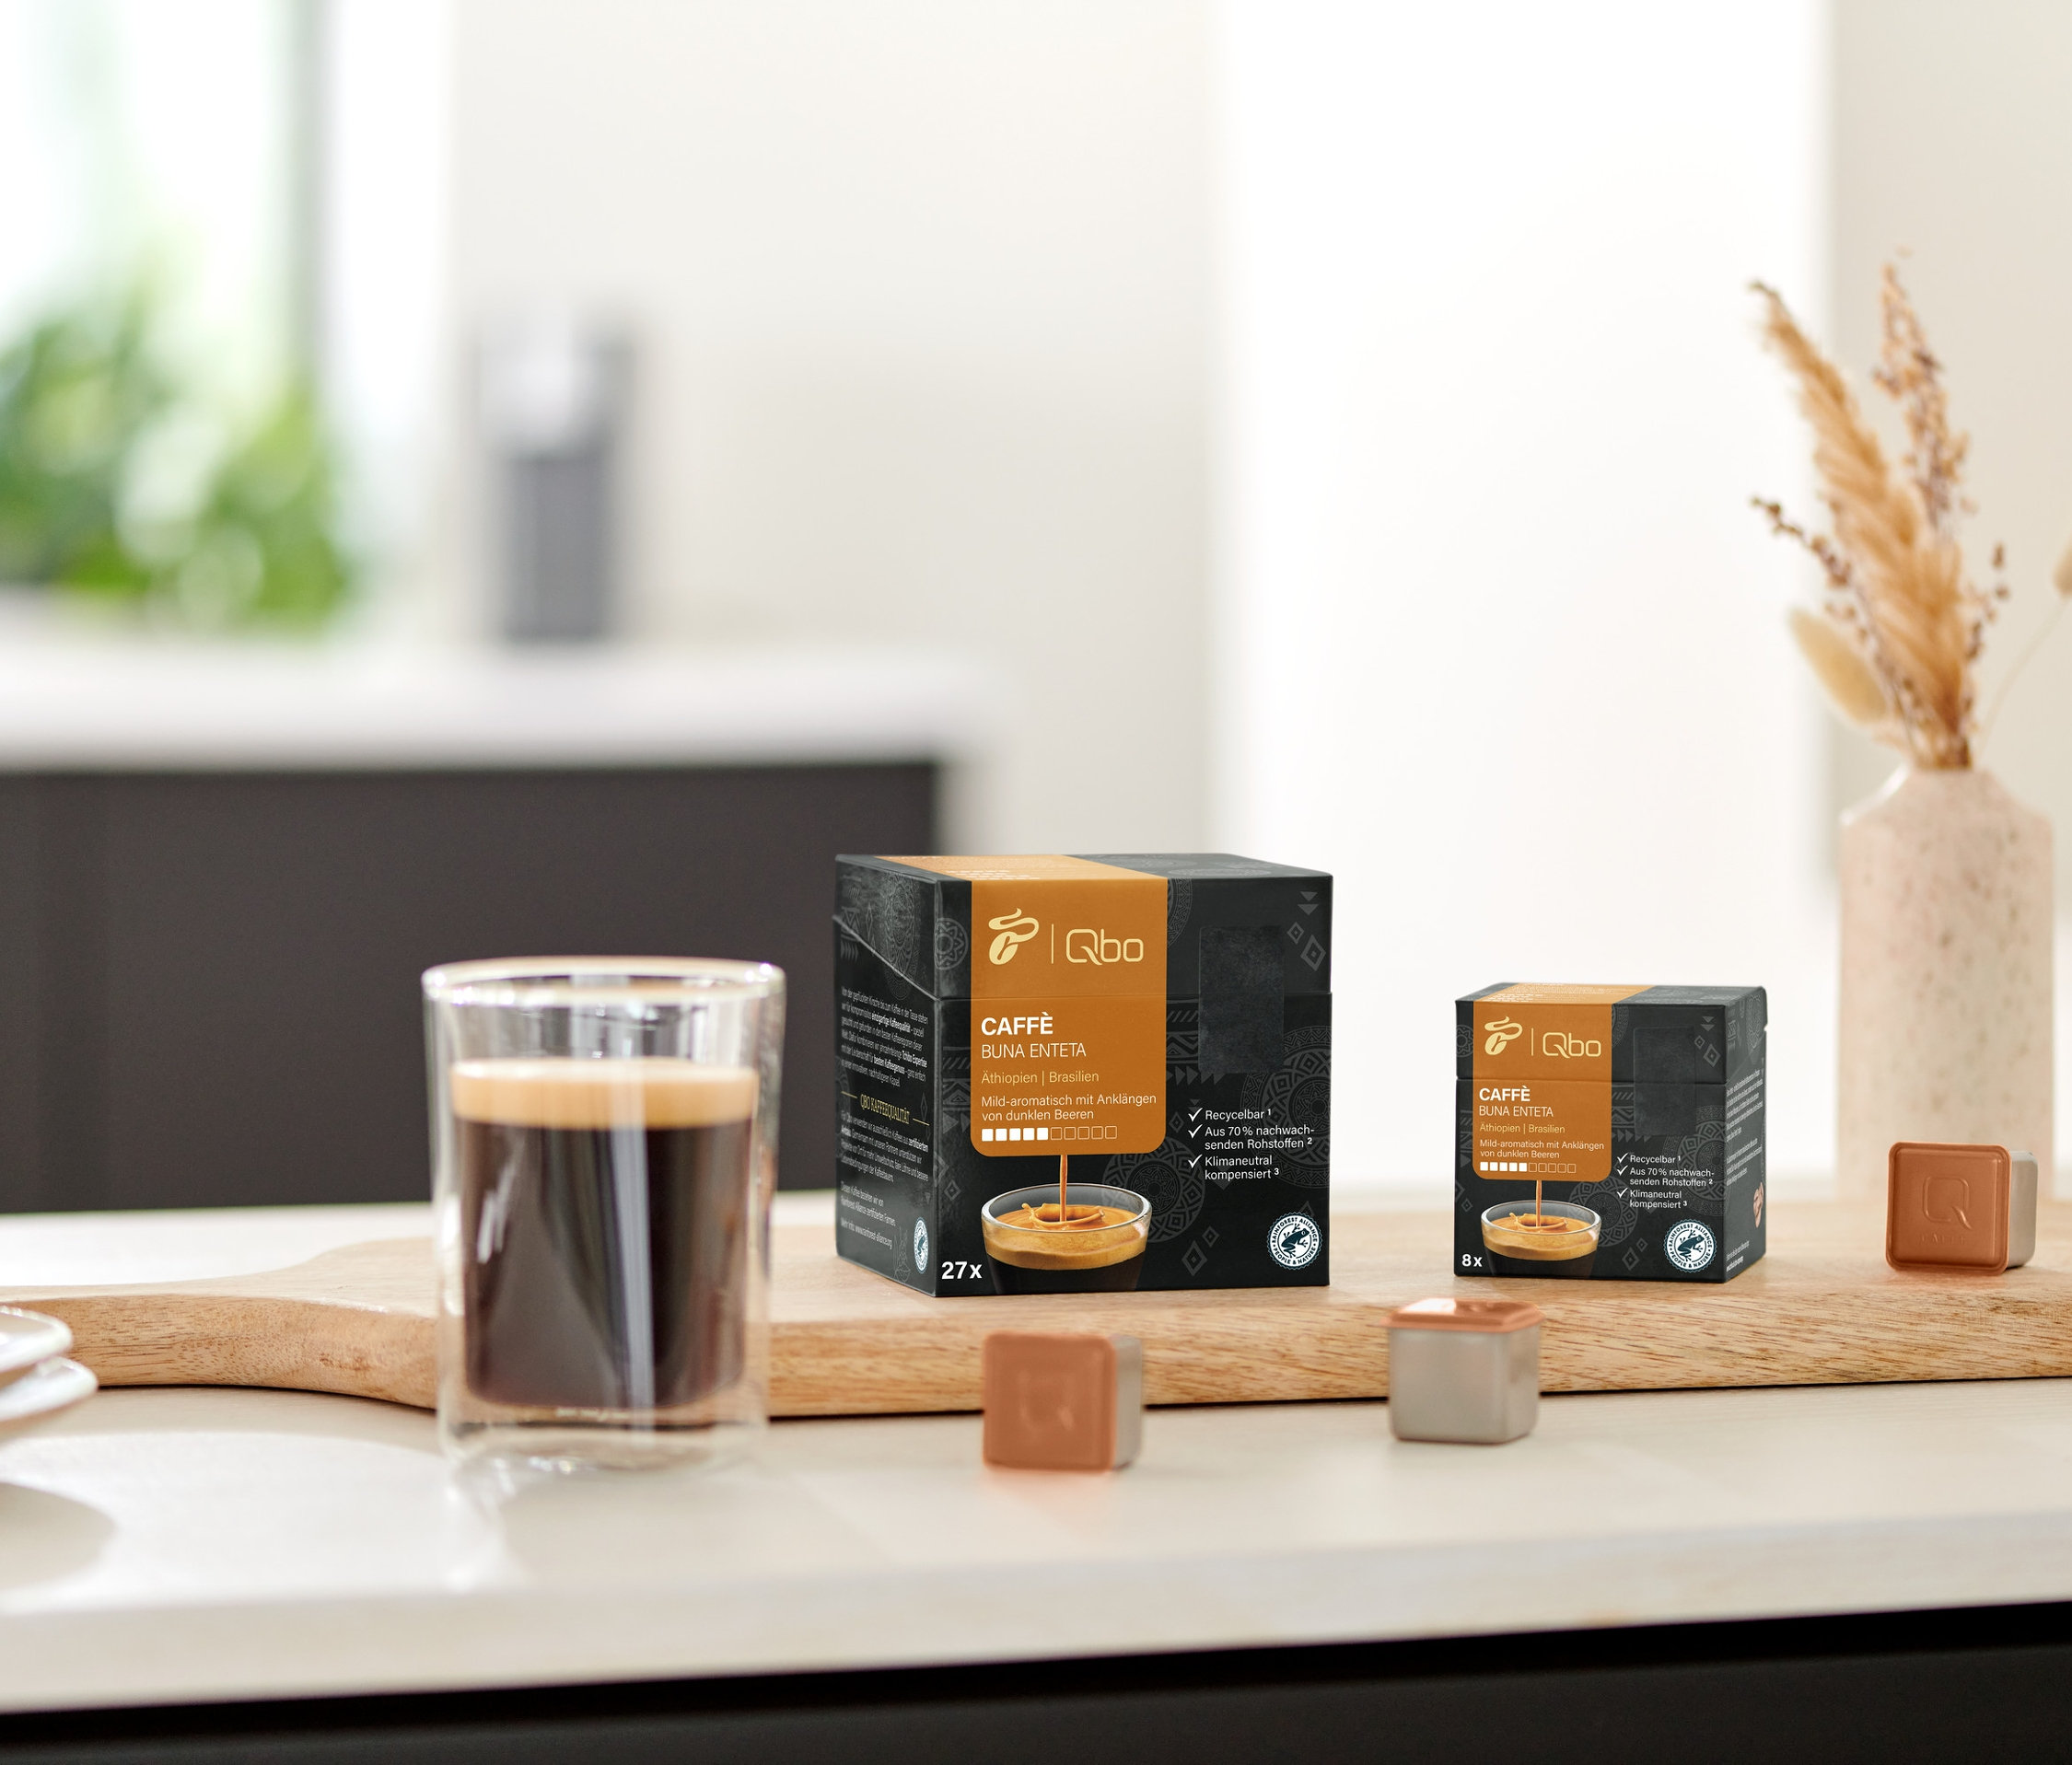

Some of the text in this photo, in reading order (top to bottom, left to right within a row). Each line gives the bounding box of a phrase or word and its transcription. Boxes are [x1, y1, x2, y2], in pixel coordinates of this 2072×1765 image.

[1065, 928, 1144, 965] Qbo
[981, 1012, 1053, 1036] CAFFÈ
[981, 1042, 1087, 1059] BUNA ENTETA
[1542, 1032, 1601, 1059] Qbo
[981, 1070, 1038, 1086] Äthiopien
[1049, 1071, 1100, 1083] Brasilien
[1479, 1085, 1531, 1102] CAFFÈ
[981, 1093, 1157, 1108] Mild-aromatisch mit Anklängen
[982, 1109, 1094, 1121] von dunklen Beeren
[1205, 1109, 1265, 1122] Recycelbar
[1479, 1105, 1554, 1118] BUNA ENTETA
[1205, 1126, 1226, 1137] Aus
[1256, 1124, 1315, 1135] nachwach-
[1479, 1121, 1520, 1134] Äthiopien
[1529, 1124, 1566, 1134] Brasilien
[1205, 1139, 1244, 1150] senden
[1247, 1138, 1304, 1149] Rohstoffen
[1480, 1139, 1605, 1152] Mild-aromatisch mit Anklängen
[1496, 1149, 1529, 1158] dunklen
[1531, 1150, 1560, 1159] Beeren
[1629, 1155, 1676, 1165] Recycelbar
[1205, 1155, 1273, 1167] Klimaneutral
[1205, 1168, 1272, 1181] kompensiert
[1629, 1167, 1646, 1176] Aus
[1669, 1168, 1715, 1178] nachwach-
[1629, 1178, 1660, 1186] senden
[1662, 1178, 1706, 1187] Rohstoffen
[1629, 1190, 1682, 1199] Klimaneutral
[1629, 1200, 1682, 1209] kompensiert
[1461, 1253, 1483, 1267] 8x
[941, 1260, 983, 1280] 27x
